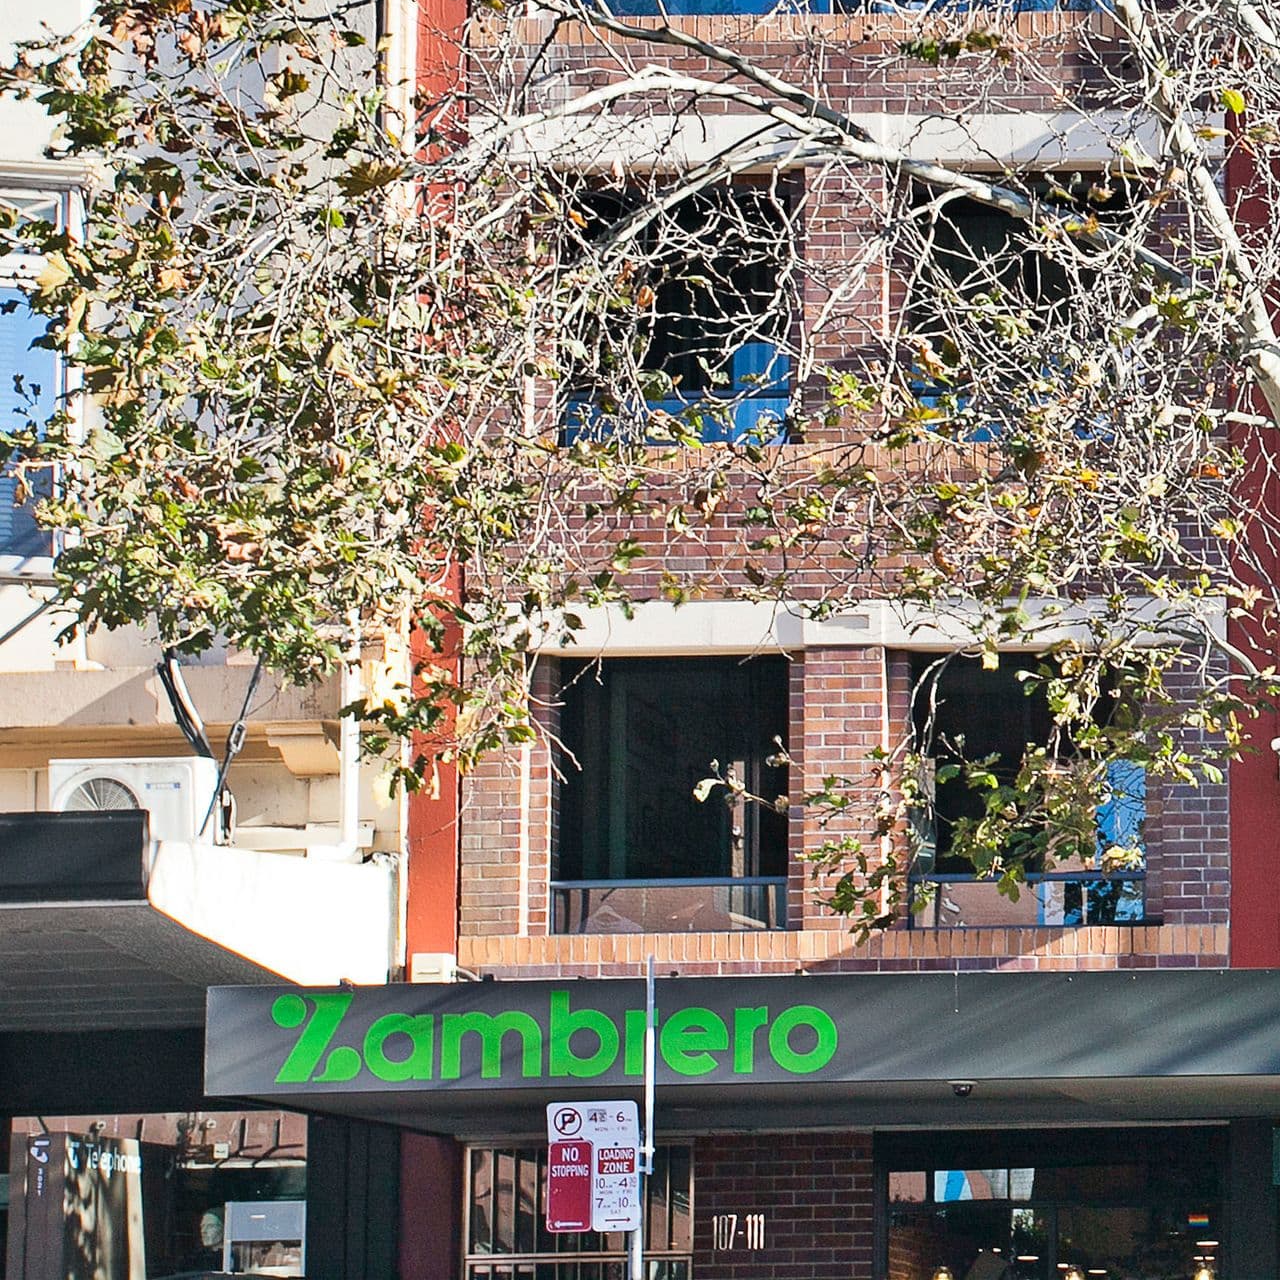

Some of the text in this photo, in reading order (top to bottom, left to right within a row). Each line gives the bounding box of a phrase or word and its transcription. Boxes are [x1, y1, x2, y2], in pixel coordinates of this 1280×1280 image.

[271, 991, 838, 1082] Zambrero
[85, 1143, 141, 1179] Telepho
[561, 1148, 579, 1162] NO
[599, 1150, 634, 1160] LOADING
[551, 1165, 589, 1177] STOPPING
[603, 1162, 630, 1173] ZONE
[713, 1214, 765, 1250] 107-111
